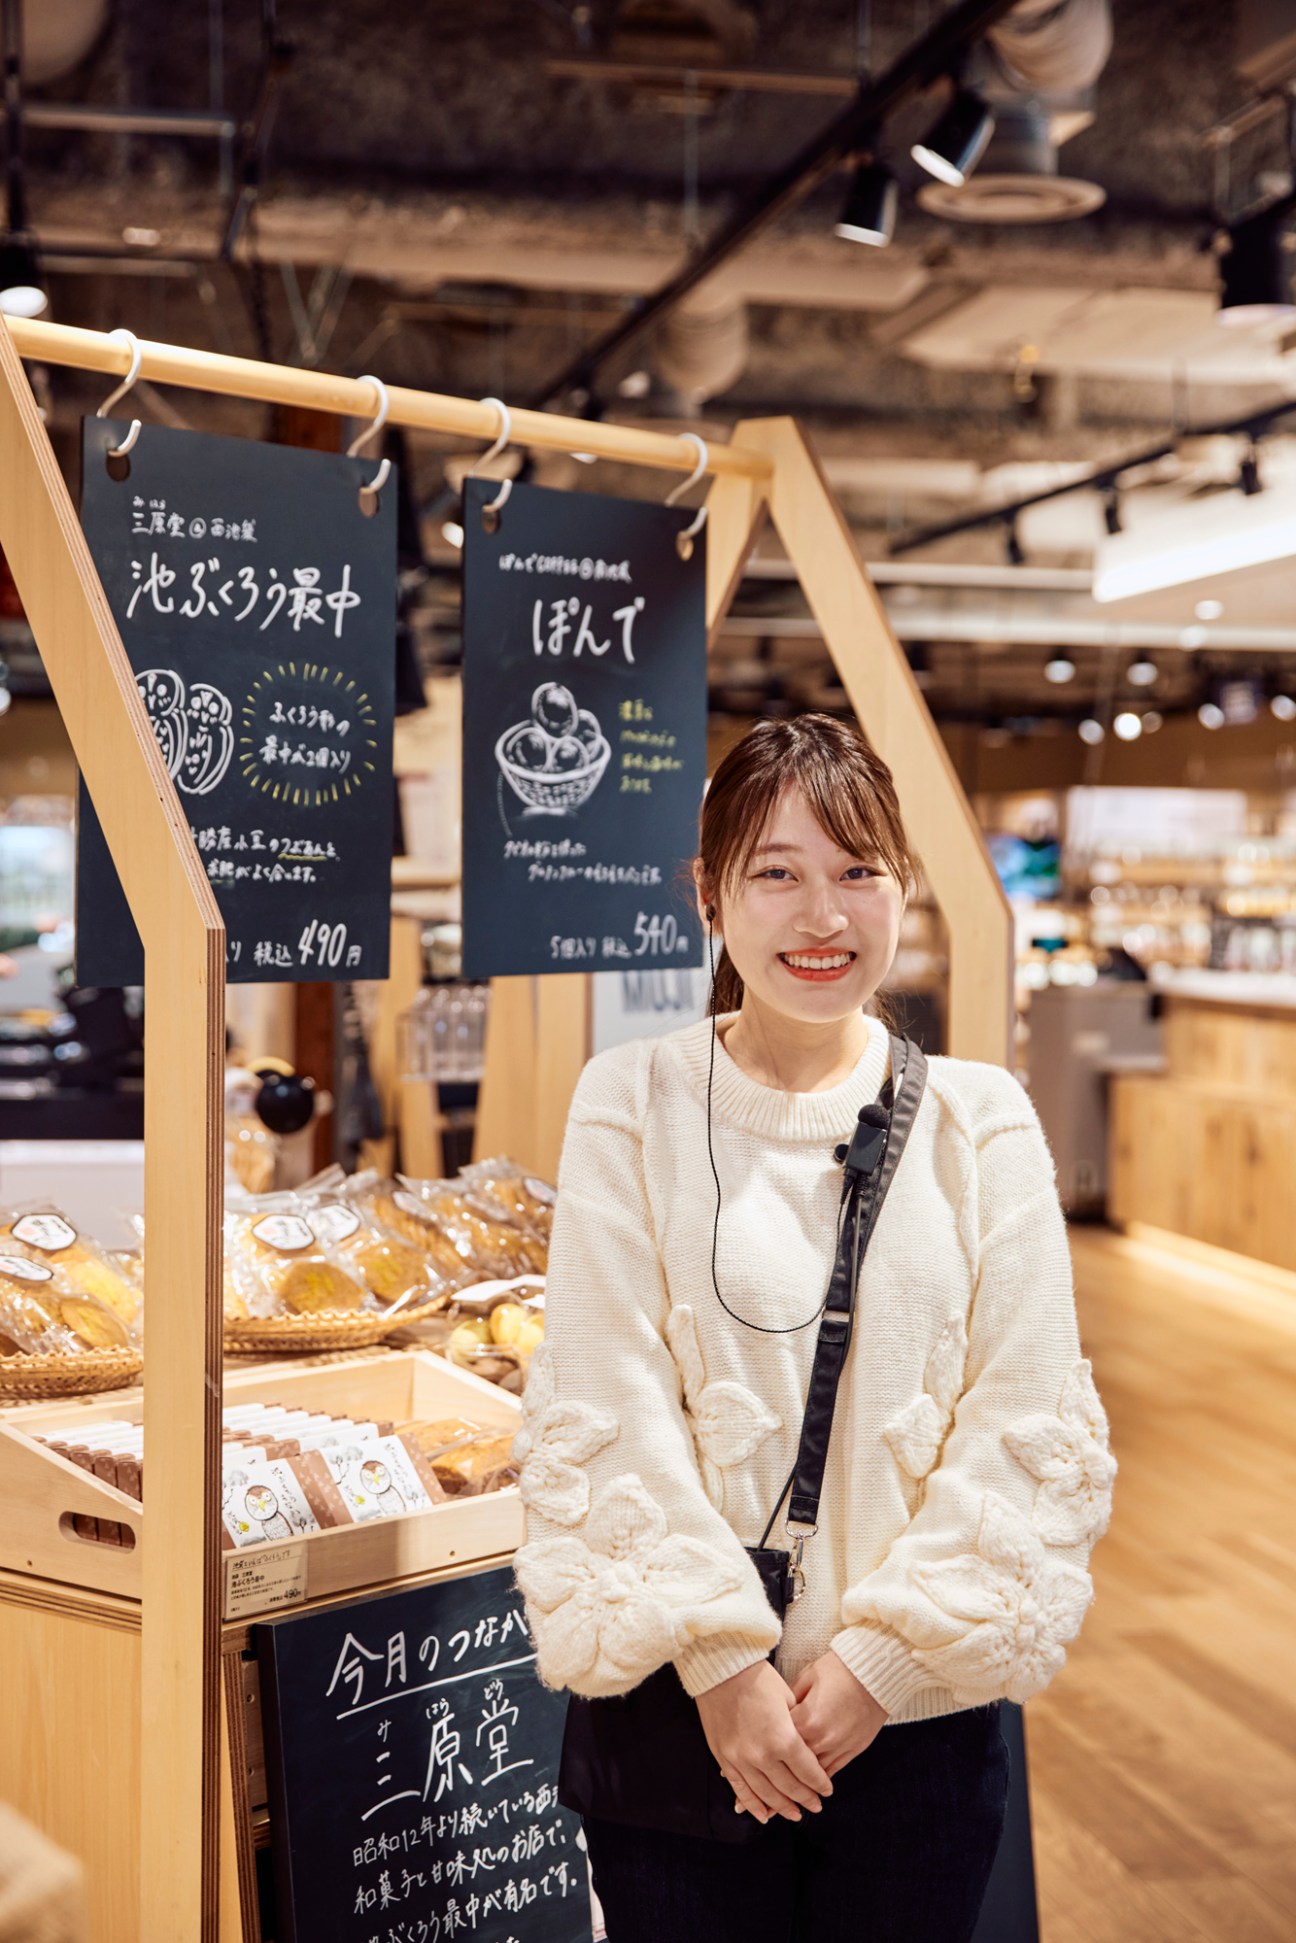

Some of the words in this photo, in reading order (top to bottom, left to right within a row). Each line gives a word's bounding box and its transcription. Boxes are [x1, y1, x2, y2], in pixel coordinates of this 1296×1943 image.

[126, 552, 361, 638] 池ぶくろう最中
[532, 596, 646, 664] ぽんで
[259, 734, 351, 774] 最中が2個入り
[376, 1718, 392, 1743] み
[425, 1697, 450, 1720] はら
[360, 1698, 535, 1822] 三原堂
